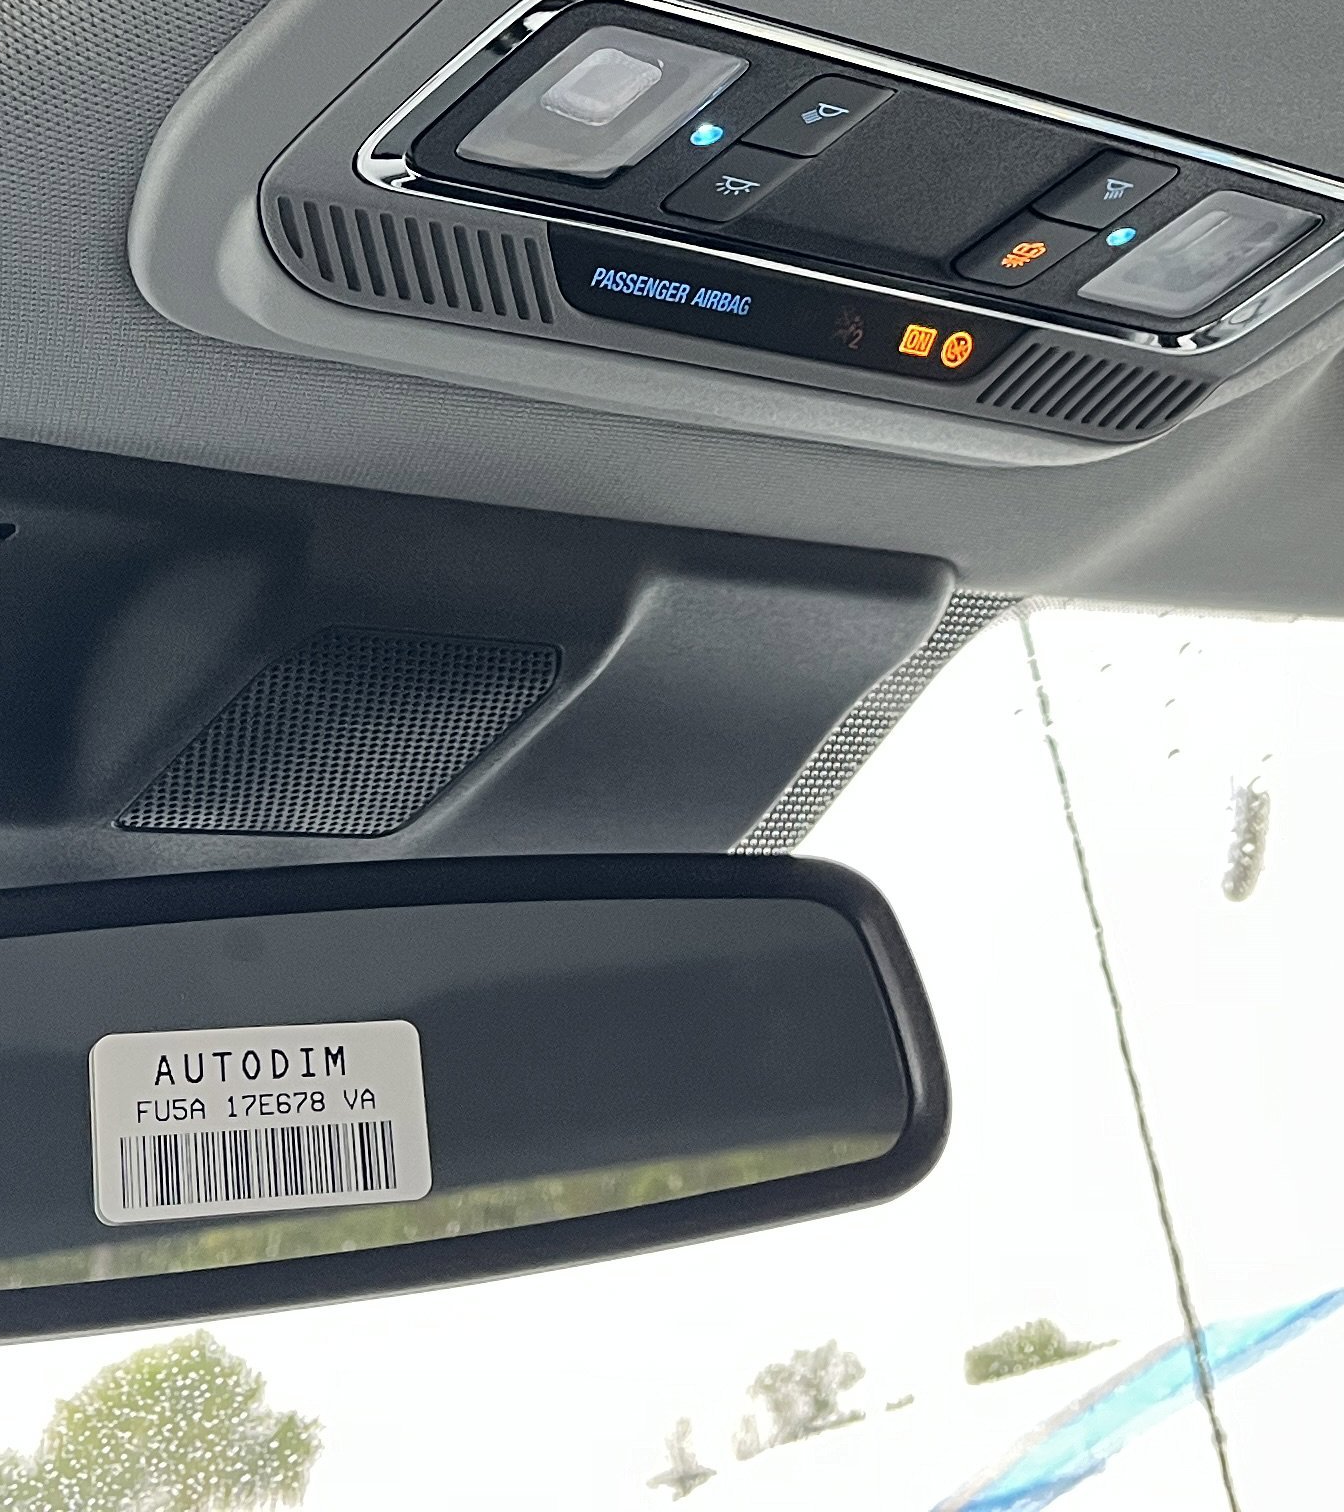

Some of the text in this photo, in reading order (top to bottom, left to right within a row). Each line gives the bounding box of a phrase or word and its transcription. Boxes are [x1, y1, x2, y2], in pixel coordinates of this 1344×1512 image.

[590, 266, 752, 316] PASSENGER AIRBAG
[154, 1045, 347, 1086] AUTODIM
[136, 1088, 376, 1124] FU5A 17E678 VA
